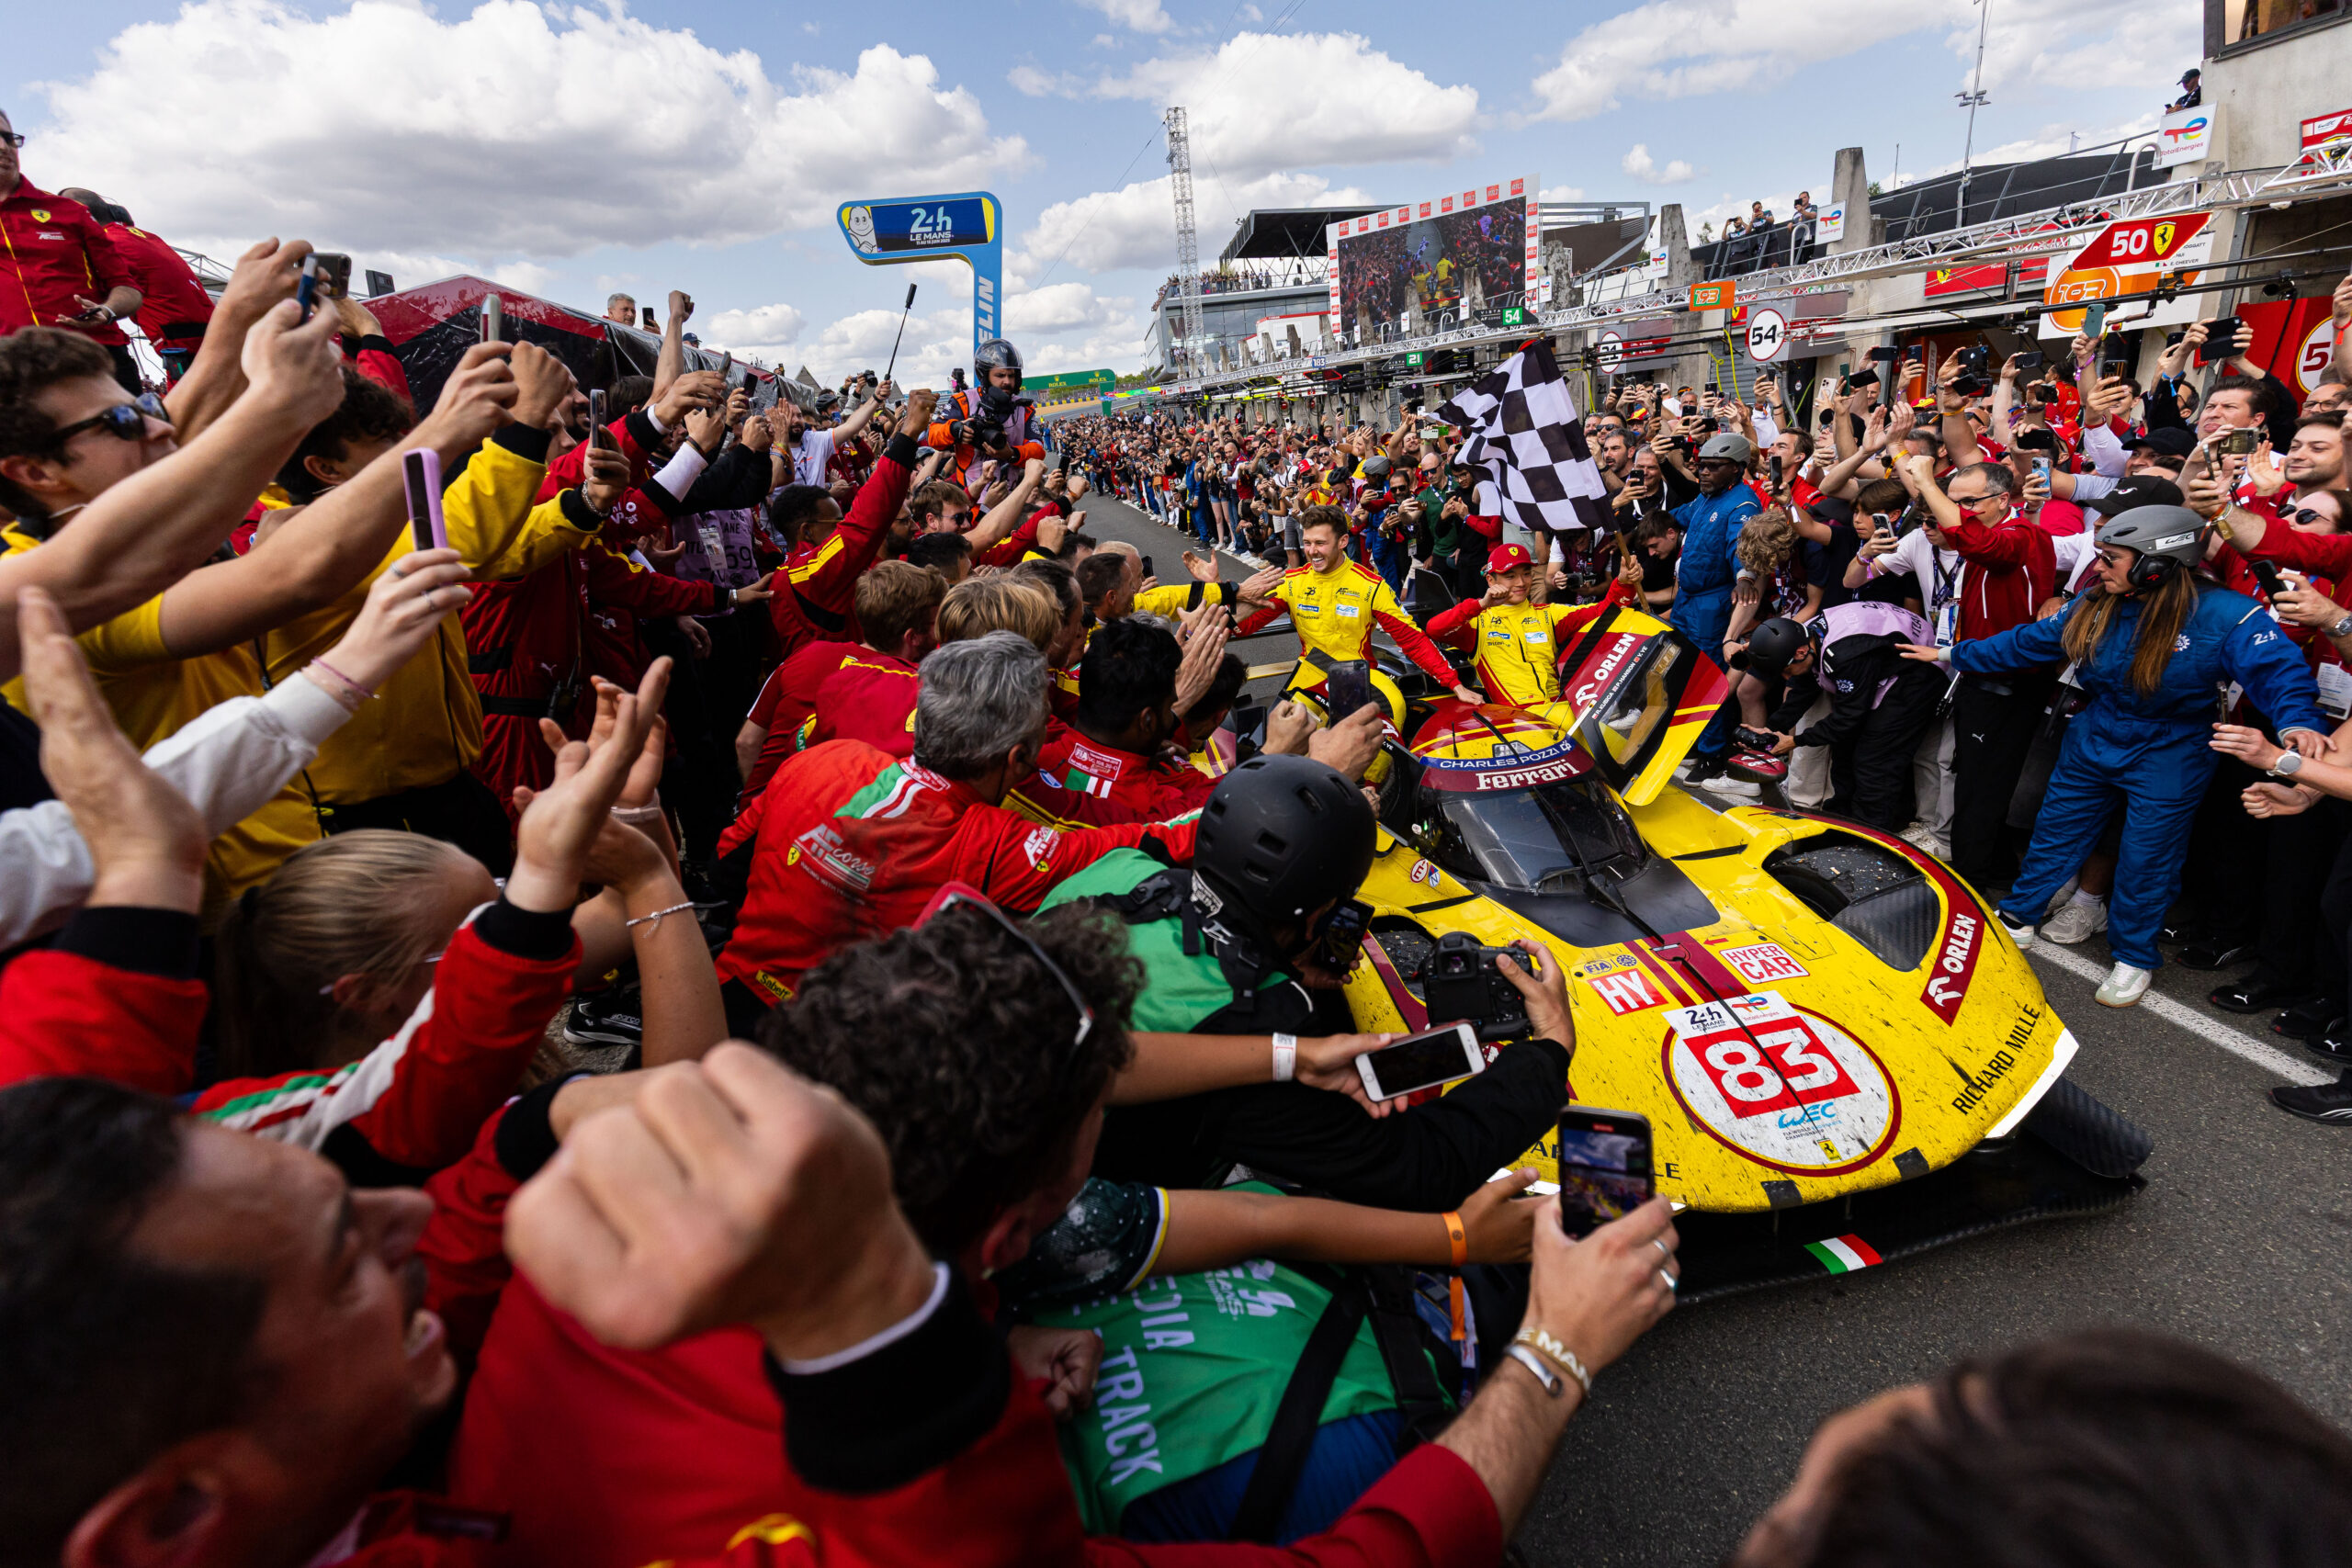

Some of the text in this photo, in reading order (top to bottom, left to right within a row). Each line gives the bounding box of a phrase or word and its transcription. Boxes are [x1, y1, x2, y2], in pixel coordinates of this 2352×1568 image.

[910, 206, 952, 233] 24h
[910, 231, 952, 242] LE MANS
[2110, 228, 2148, 257] 50
[1695, 289, 1719, 305] 193
[978, 276, 993, 344] ELIN
[1505, 310, 1521, 323] 54
[1751, 324, 1778, 346] 54
[1314, 357, 1326, 367] 183
[1408, 354, 1420, 364] 21
[2302, 341, 2335, 373] 5
[724, 522, 741, 534] ANE
[2165, 534, 2193, 545] WEC
[1594, 633, 1636, 681] ORLEN
[1440, 749, 1560, 769] CHARLES POZZI
[1476, 759, 1580, 791] Ferrari
[1725, 945, 1785, 964] HYPER
[1942, 913, 1977, 974] ORLEN
[1585, 963, 1611, 974] FIA
[1739, 956, 1804, 980] CAR
[760, 974, 790, 999] Sabelt
[1592, 970, 1655, 1013] HY
[1685, 1006, 1723, 1025] 24h
[1701, 1019, 1725, 1028] MANS
[1743, 1010, 1780, 1021] TotalEnergies
[1705, 1027, 1838, 1102] 83
[1951, 1004, 2040, 1115] RICHARD MILLE
[1778, 1102, 1837, 1129] WEC
[1097, 1346, 1163, 1485] TRACK
